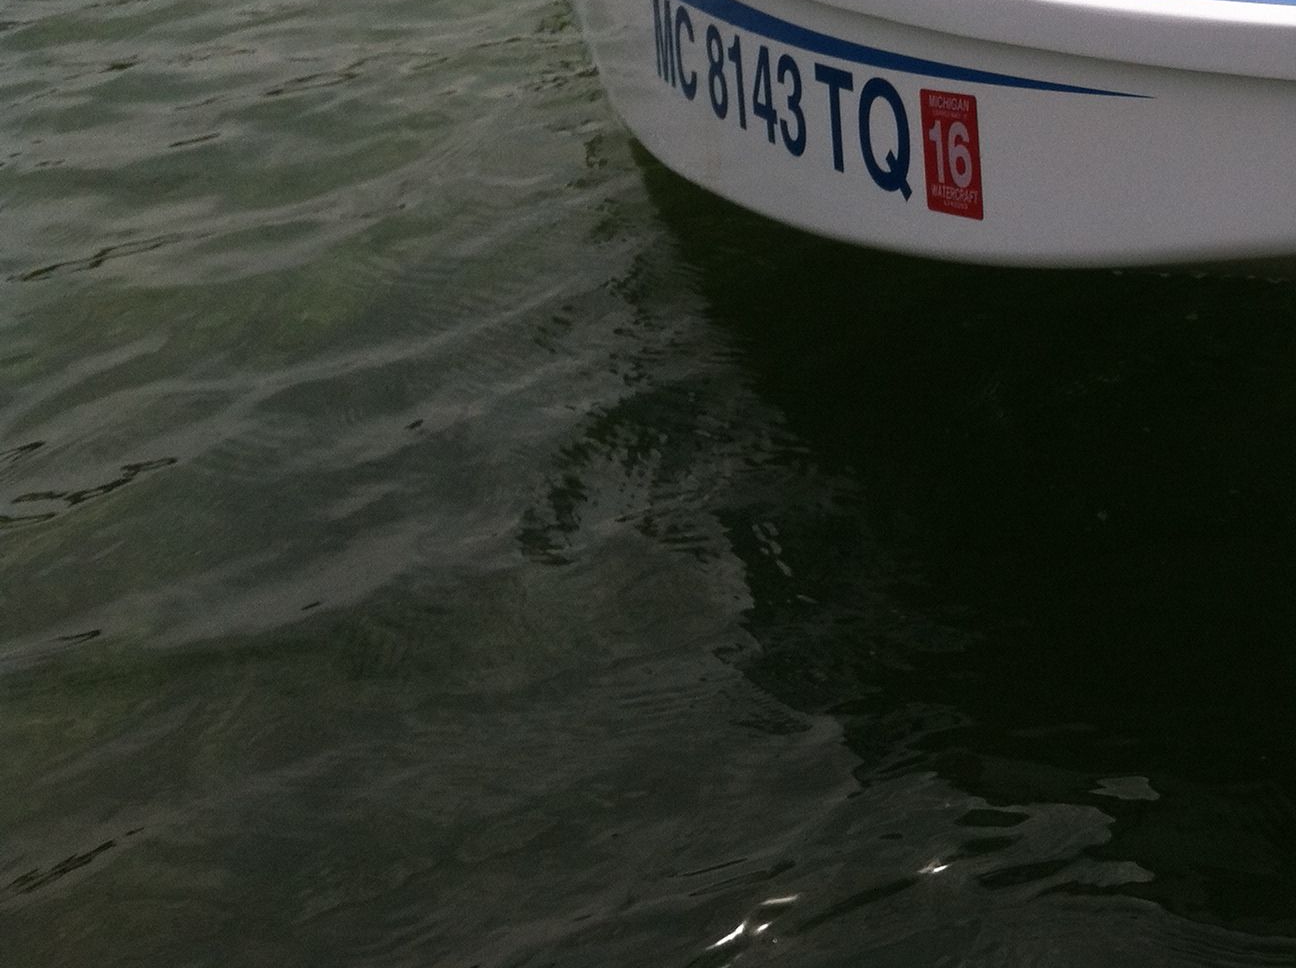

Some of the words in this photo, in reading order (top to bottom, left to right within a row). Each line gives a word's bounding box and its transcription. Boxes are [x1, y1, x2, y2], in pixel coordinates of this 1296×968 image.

[706, 24, 806, 158] 8143
[814, 62, 912, 201] TQ
[928, 94, 970, 112] MICHIGAN
[928, 119, 973, 188] 16
[931, 184, 978, 204] WATERCRAFT
